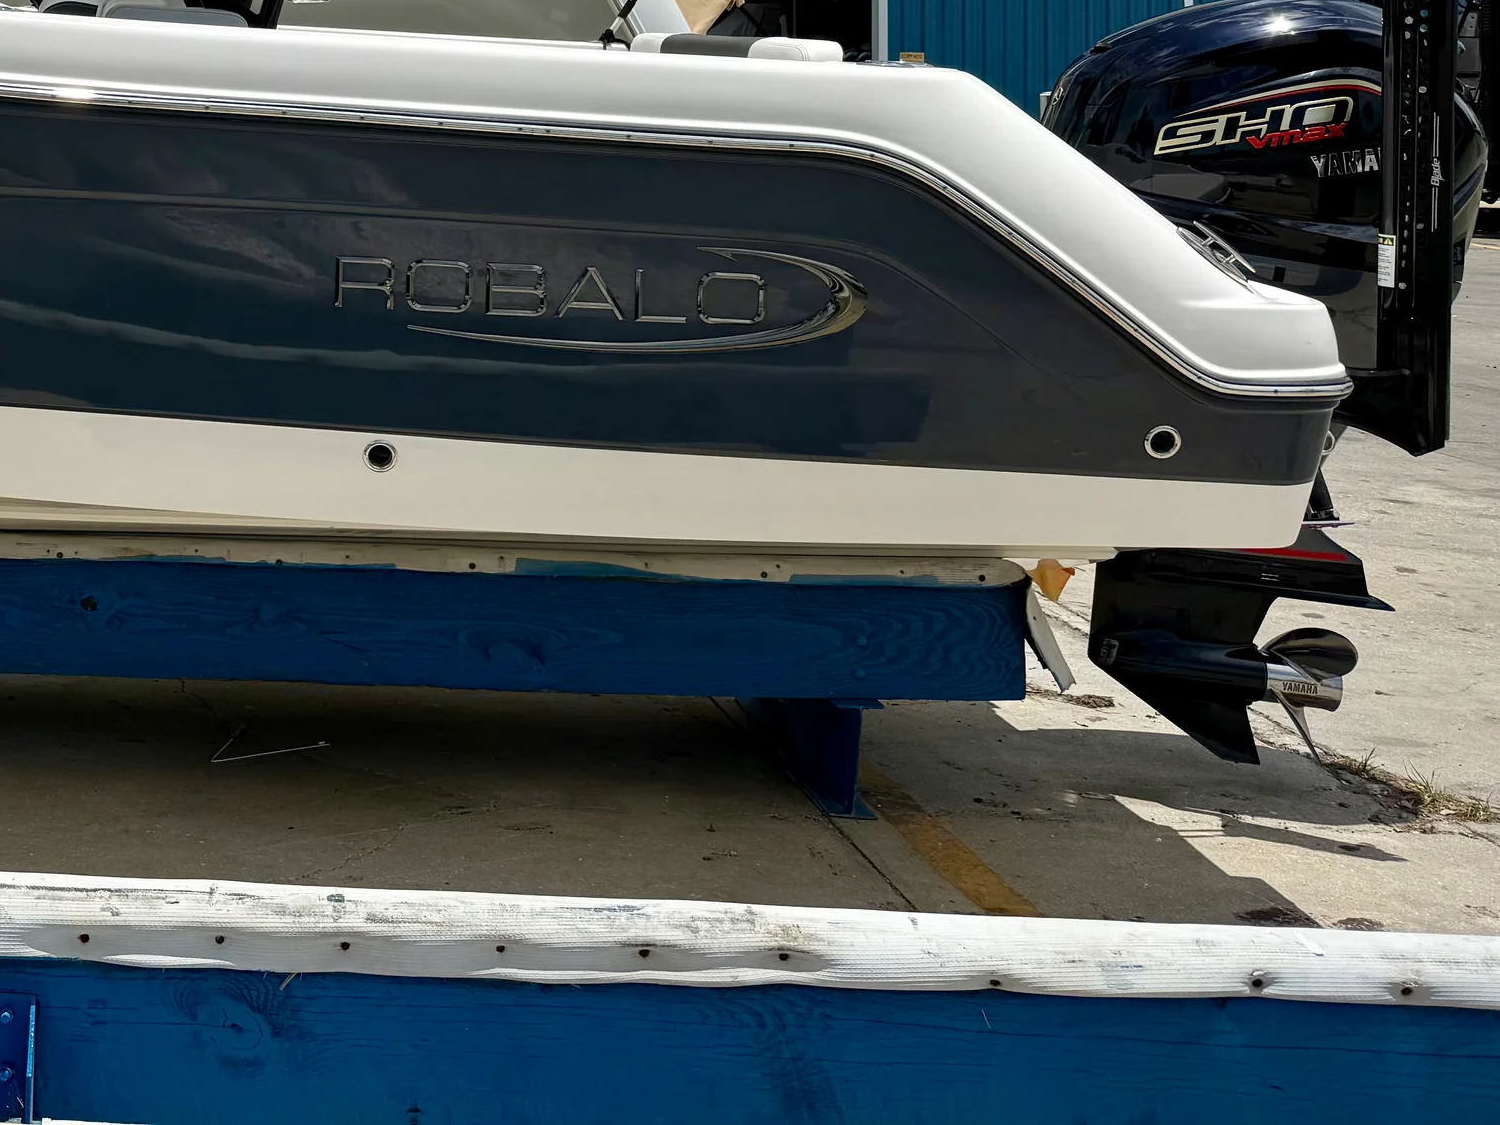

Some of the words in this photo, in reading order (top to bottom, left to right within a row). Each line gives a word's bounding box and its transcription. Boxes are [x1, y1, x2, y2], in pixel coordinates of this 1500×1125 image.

[1153, 96, 1354, 155] SHO
[1310, 147, 1381, 178] YAMA
[1431, 158, 1445, 186] Blade
[334, 255, 767, 325] ROBALO
[1282, 681, 1318, 695] YAMAHA
